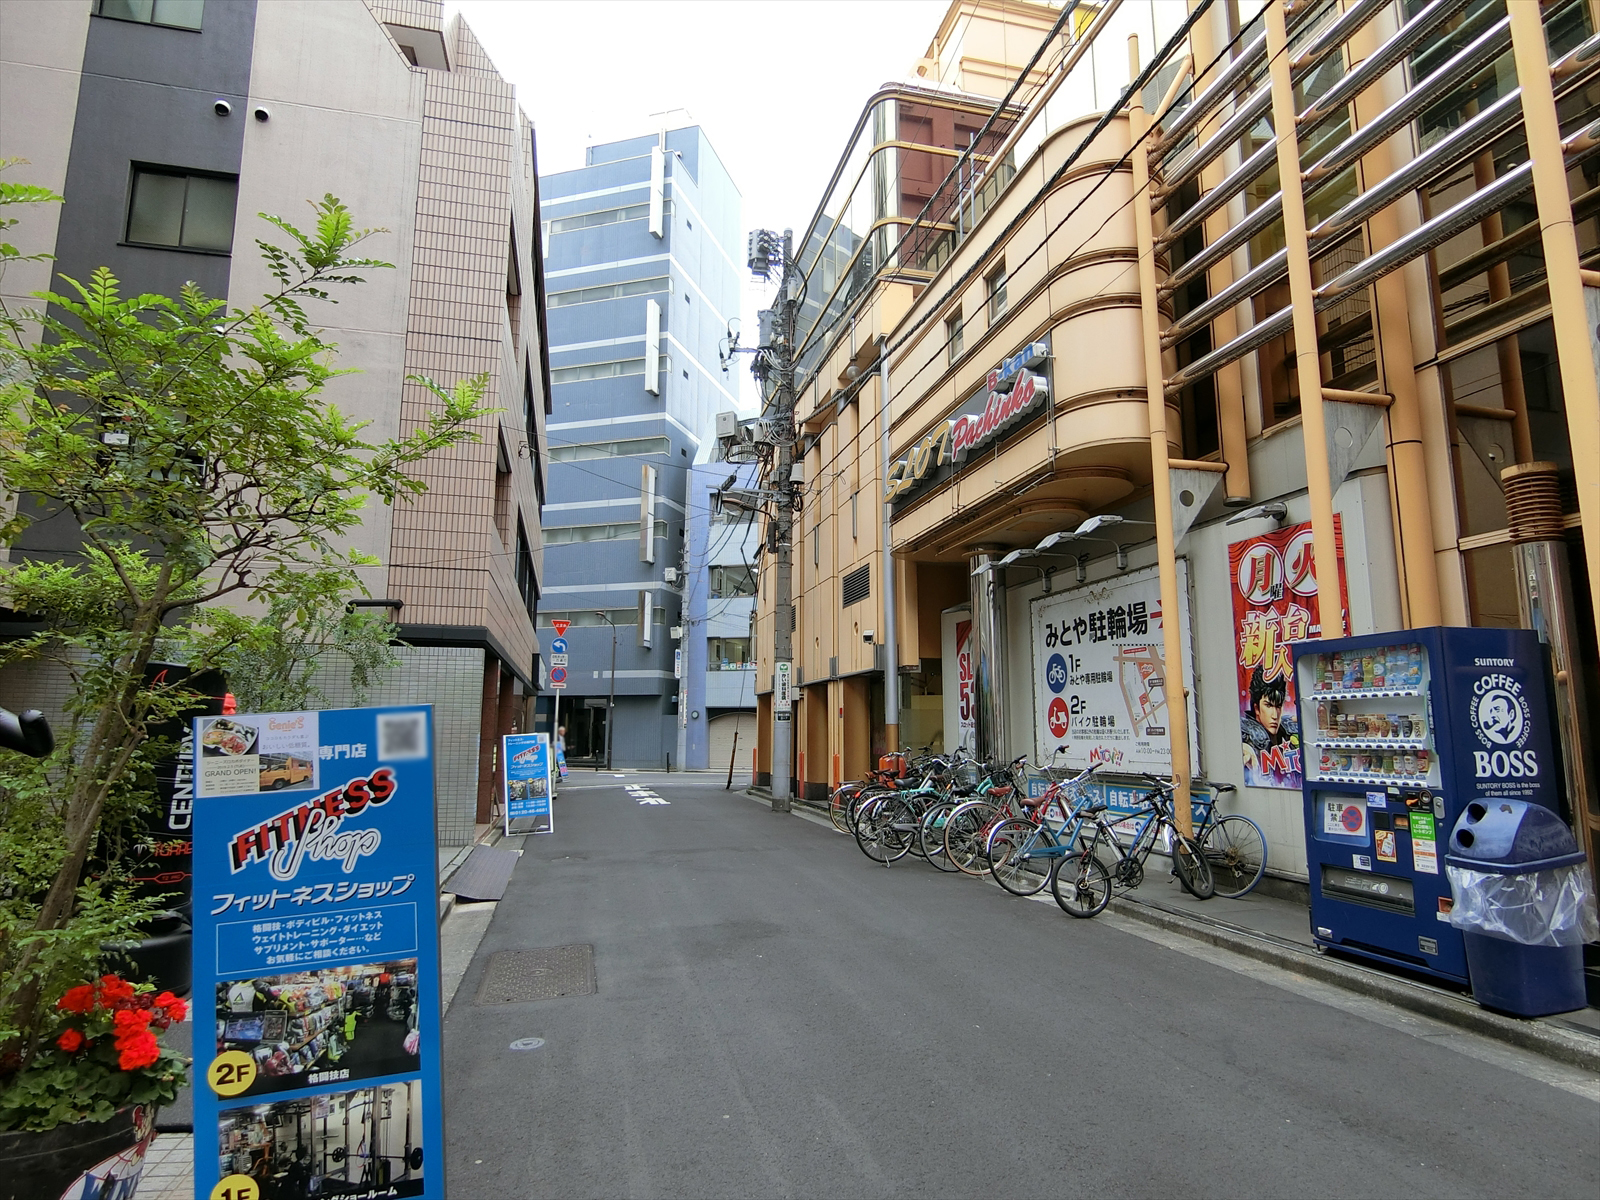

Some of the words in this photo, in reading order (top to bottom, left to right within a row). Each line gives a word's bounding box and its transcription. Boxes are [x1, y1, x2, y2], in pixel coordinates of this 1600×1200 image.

[884, 420, 950, 503] SLOT
[952, 367, 1036, 462] Pachinko
[1045, 601, 1148, 648] みとや駐輪場
[1069, 654, 1081, 674] 1F
[1474, 657, 1515, 667] SUNTORY
[1069, 670, 1113, 687] みとや専用駐輪場
[1473, 673, 1522, 696] COFFEE
[1070, 695, 1087, 715] 2F
[1469, 695, 1480, 728] COFFEE
[1518, 696, 1531, 718] BOSS
[1071, 714, 1116, 729] バイク駐輪場
[1475, 728, 1493, 749] BOSS
[1515, 720, 1531, 749] COFFEE
[319, 743, 368, 761] 専門店
[204, 769, 232, 777] GRAND
[233, 768, 257, 776] OPEN!
[1472, 750, 1539, 778] BOSS
[1327, 802, 1344, 812] 駐車
[231, 769, 395, 872] FITNESS
[1330, 813, 1347, 823] 禁止
[210, 874, 416, 916] フィットネスショップ
[252, 911, 383, 933] 格闘技・ボディビル・フィットネス
[252, 921, 384, 944] ウェイトトレーニング・ダイエット
[266, 945, 370, 964] お気軽にご相談ください。
[216, 1063, 251, 1086] 2F
[308, 1069, 350, 1085] 格闘技店
